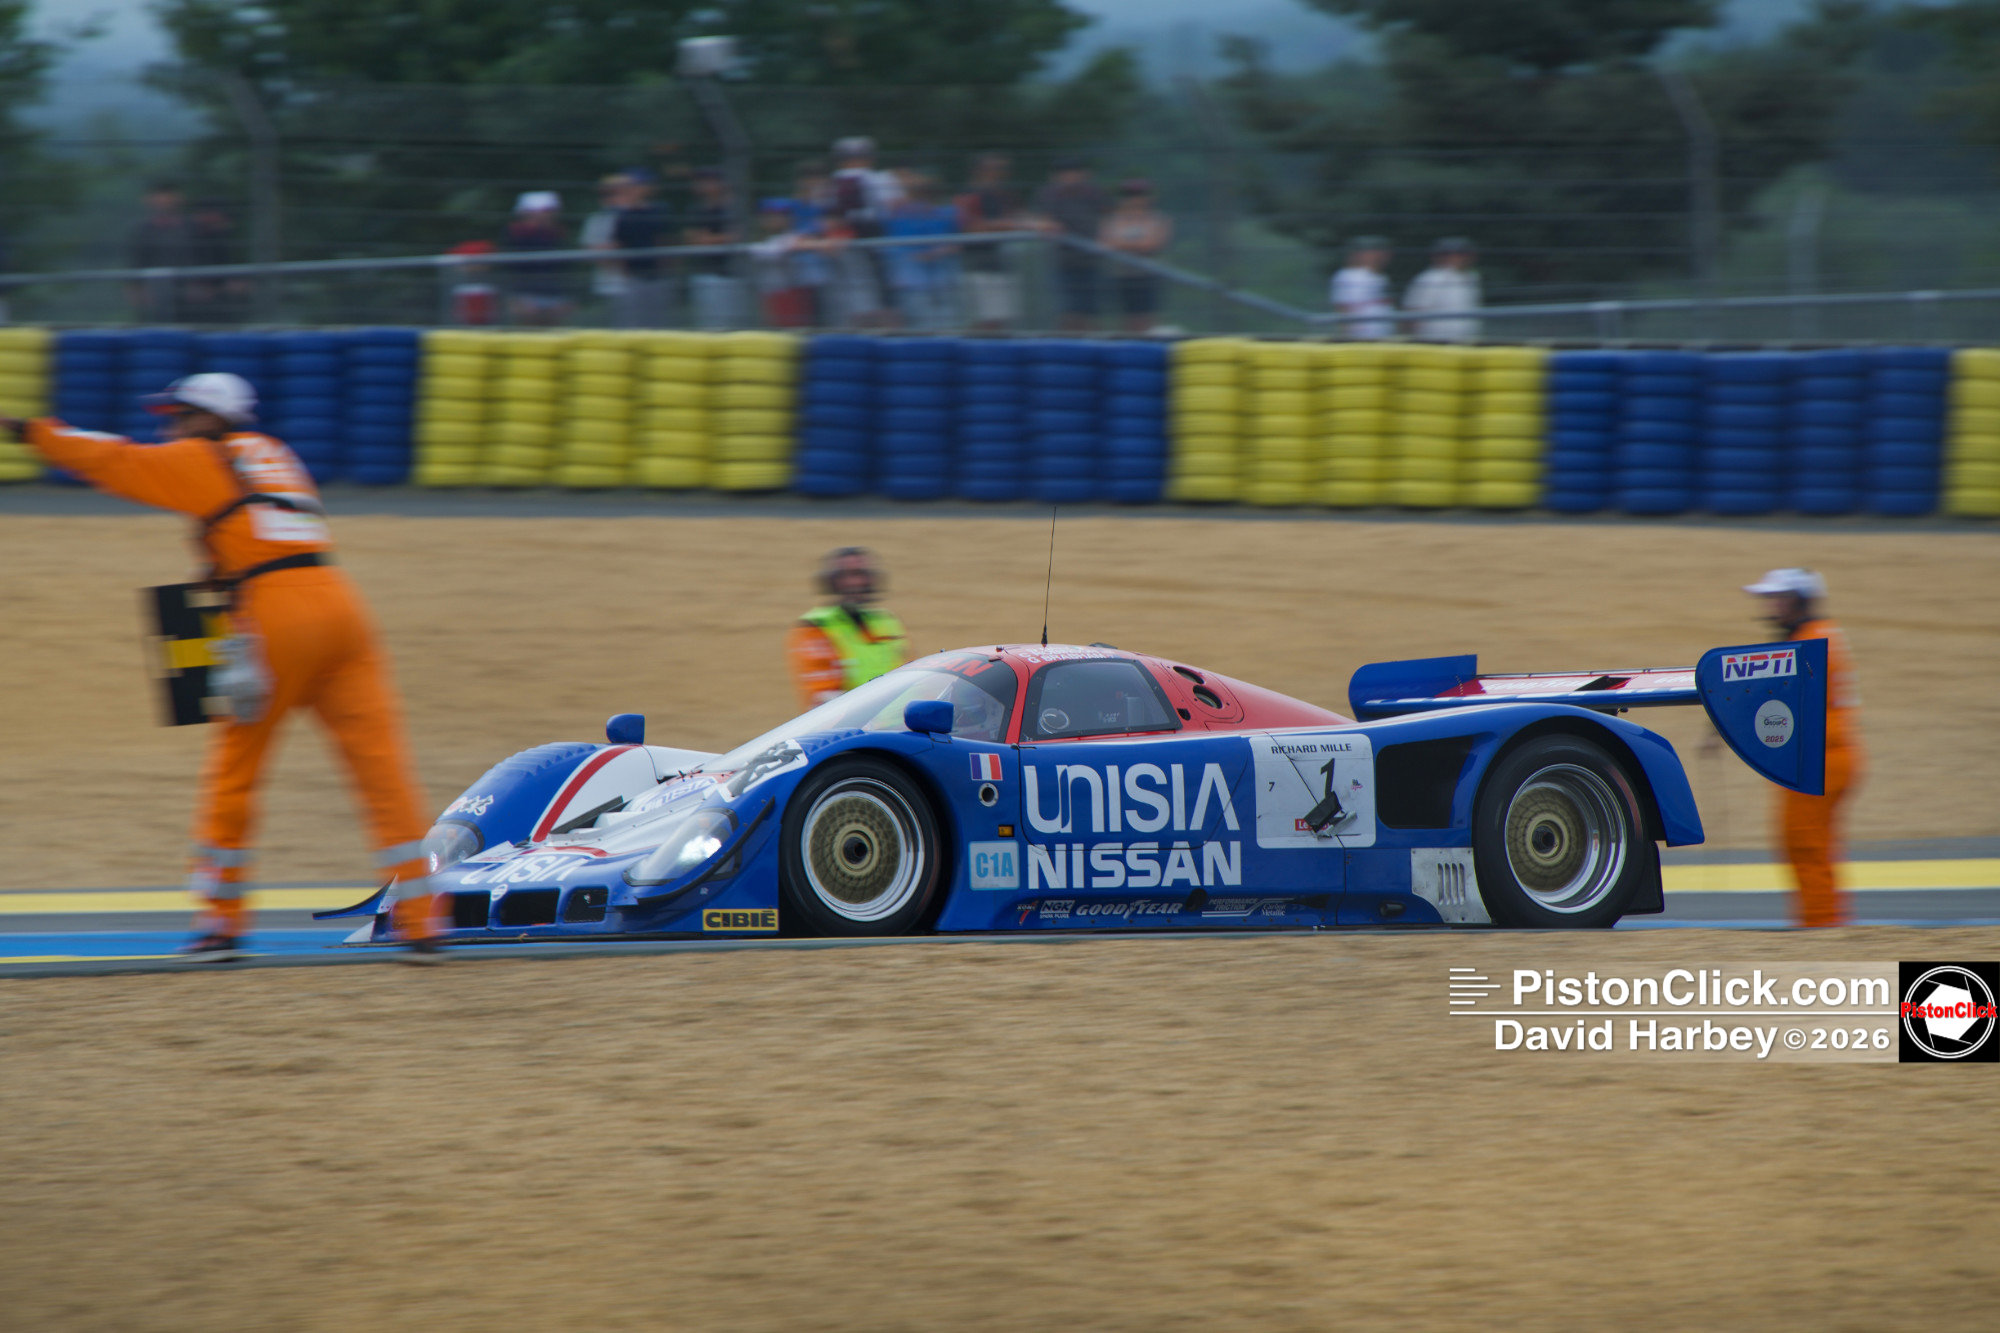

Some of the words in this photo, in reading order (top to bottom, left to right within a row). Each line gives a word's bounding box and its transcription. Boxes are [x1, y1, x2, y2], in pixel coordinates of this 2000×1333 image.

[1271, 744, 1318, 755] RICHARD
[1320, 743, 1352, 753] MILLE
[1268, 781, 1276, 792] 7
[1023, 762, 1241, 834] UNISIA
[975, 851, 1014, 879] C1A
[1027, 841, 1242, 889] NISSAN
[1040, 900, 1075, 913] NGK
[1076, 900, 1183, 919] GOODYEAR
